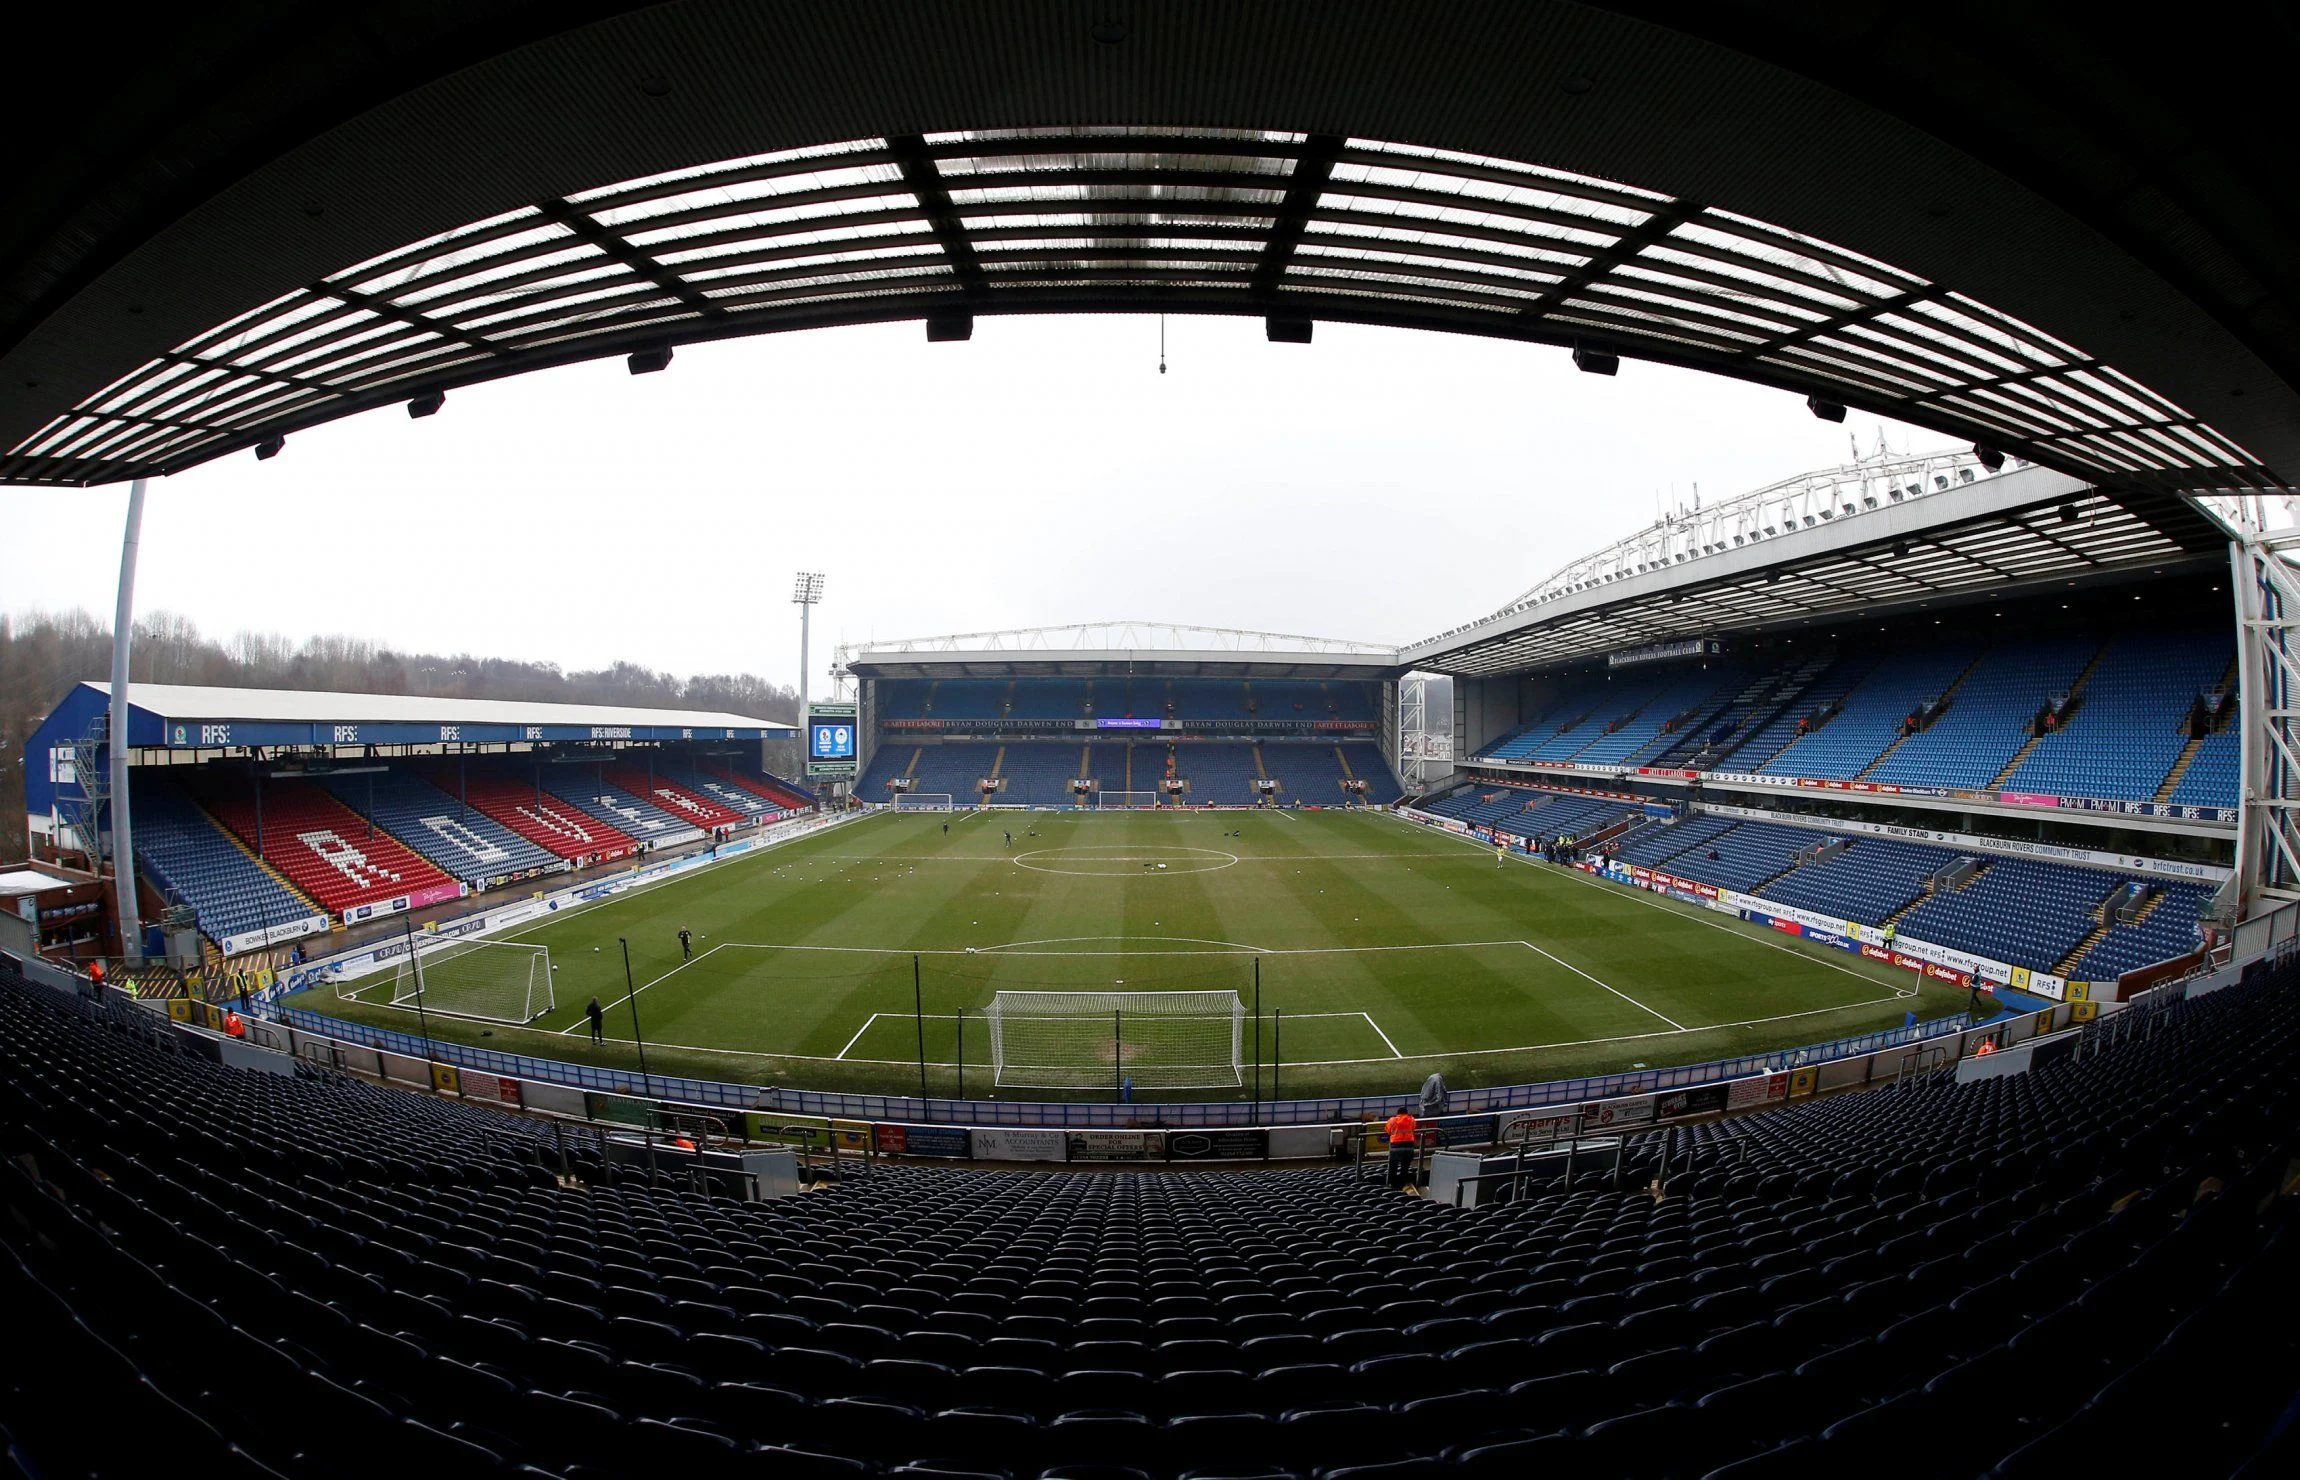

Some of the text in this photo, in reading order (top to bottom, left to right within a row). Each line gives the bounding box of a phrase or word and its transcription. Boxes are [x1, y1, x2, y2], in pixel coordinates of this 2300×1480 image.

[1657, 648, 1681, 658] FOOTBALL
[1887, 826, 1928, 838] FAMILY STAND
[1980, 838, 2091, 860] BLACKBURN ROVERS COMMUNITY TRUST
[2153, 862, 2204, 876] brfctrust.co.uk
[1739, 898, 1782, 916] www.rfsgroup.net
[1796, 913, 1845, 931] www.rfsgroup.net
[1869, 947, 1888, 960] dafabet
[1935, 967, 1957, 981] dafabet
